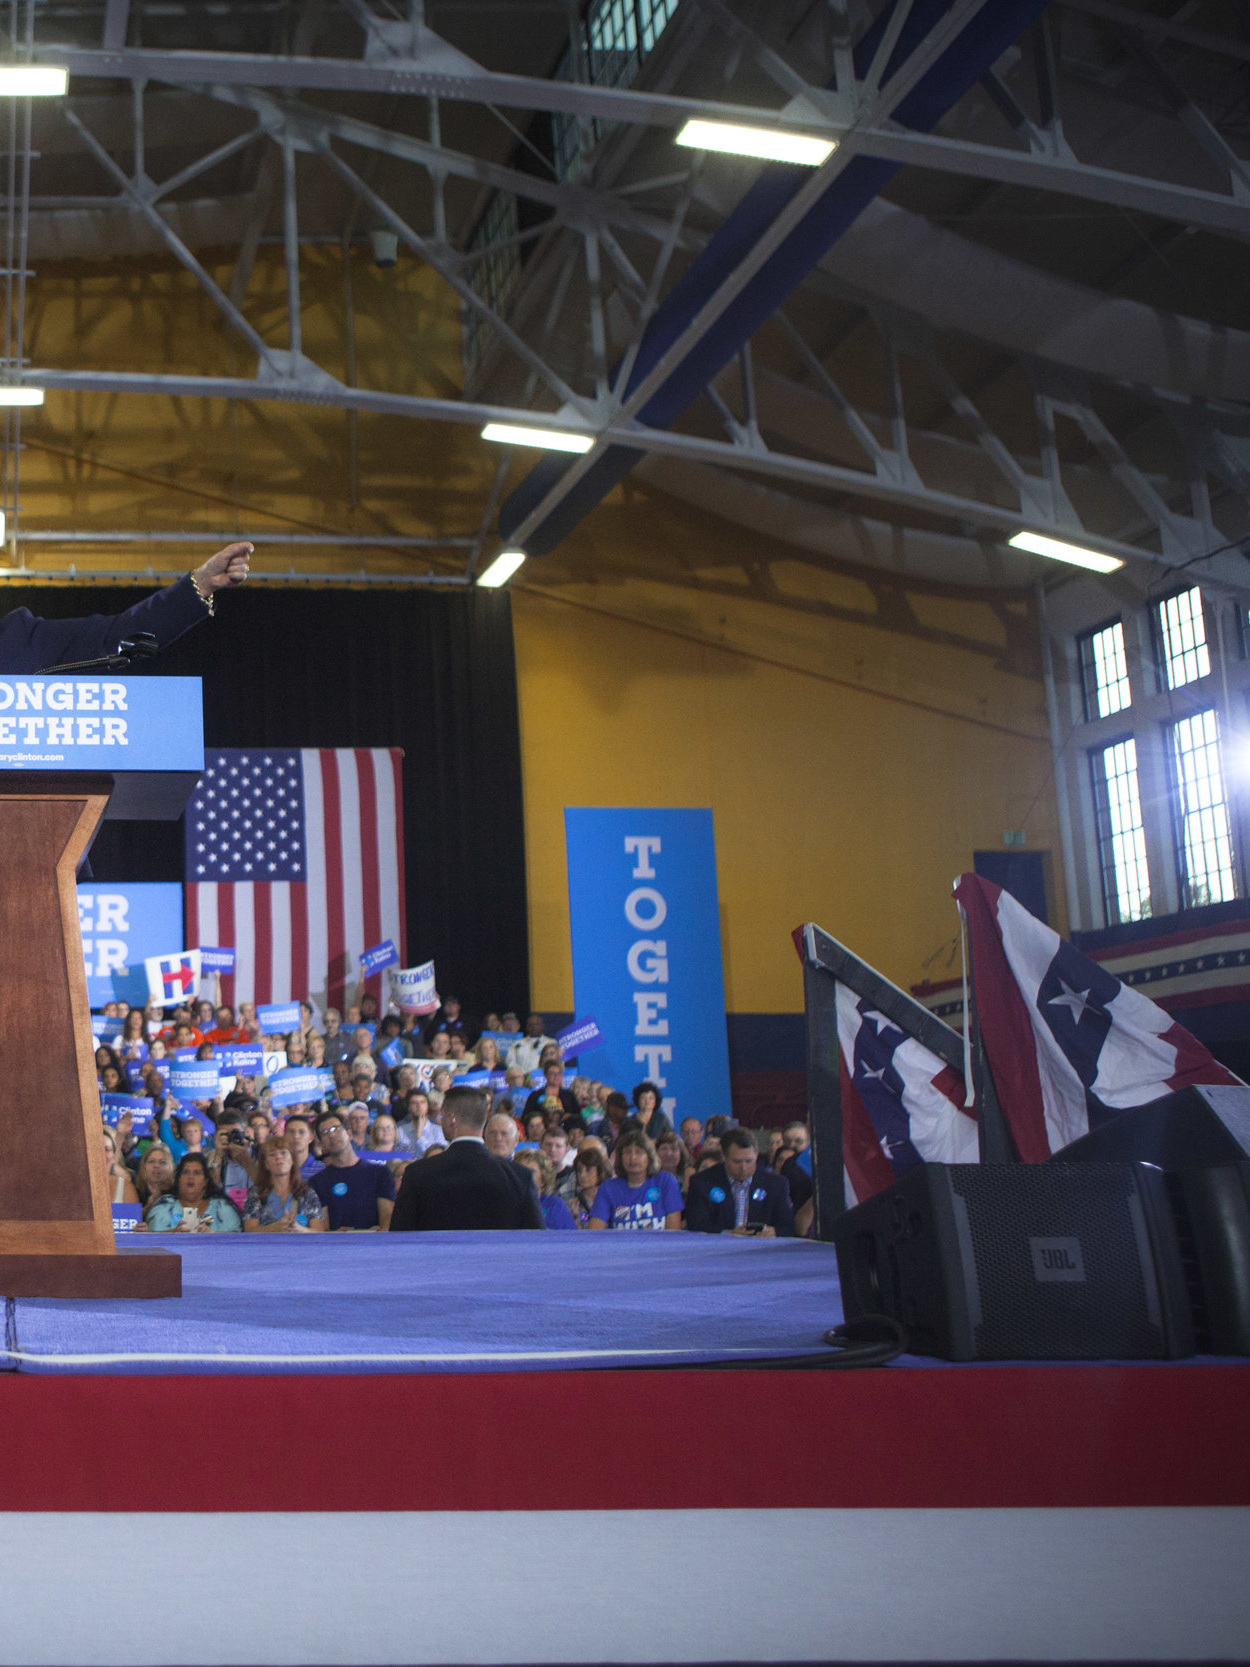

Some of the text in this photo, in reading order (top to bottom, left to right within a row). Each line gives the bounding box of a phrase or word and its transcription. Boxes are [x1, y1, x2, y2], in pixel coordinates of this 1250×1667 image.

[233, 1051, 263, 1059] Clinton
[233, 1058, 257, 1067] Kaine
[171, 1070, 219, 1079] STRONGER
[171, 1079, 218, 1088] TOGETHER
[1040, 1249, 1077, 1269] JBL
